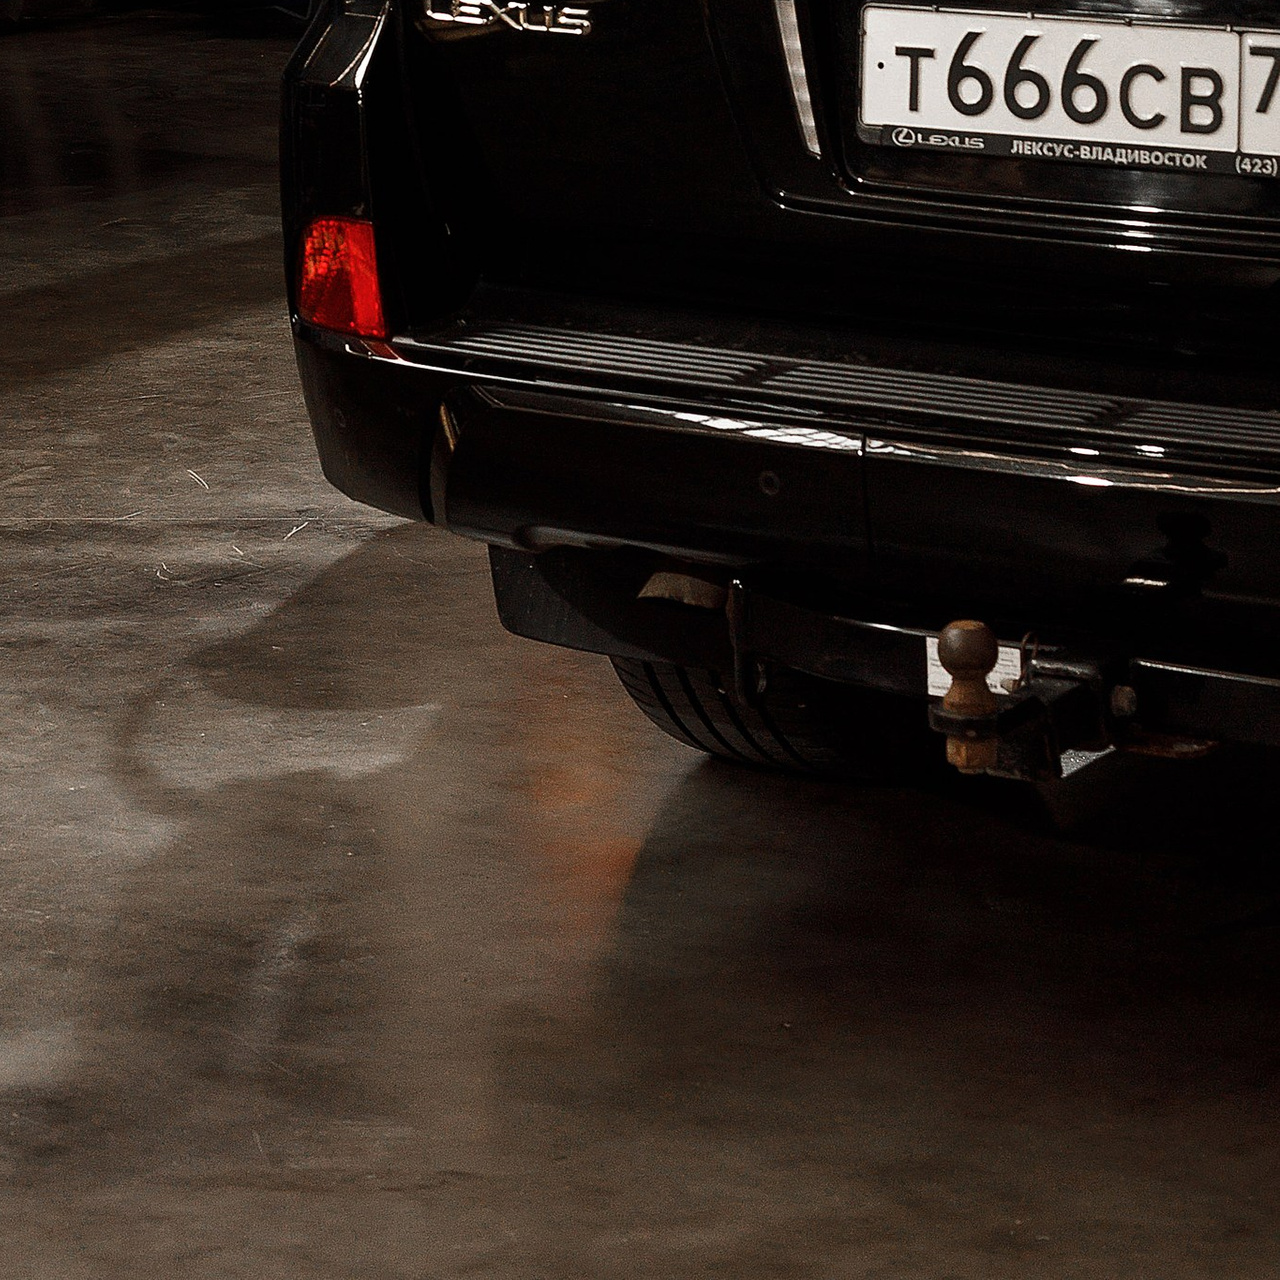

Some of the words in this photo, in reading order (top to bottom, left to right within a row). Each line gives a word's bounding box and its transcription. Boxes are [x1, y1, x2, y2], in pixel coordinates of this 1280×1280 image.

[917, 134, 985, 150] LEXUS
[1010, 139, 1208, 170] ЛЕКСУС-ВЛАДИВОСТОК
[1235, 155, 1278, 177] (423)
